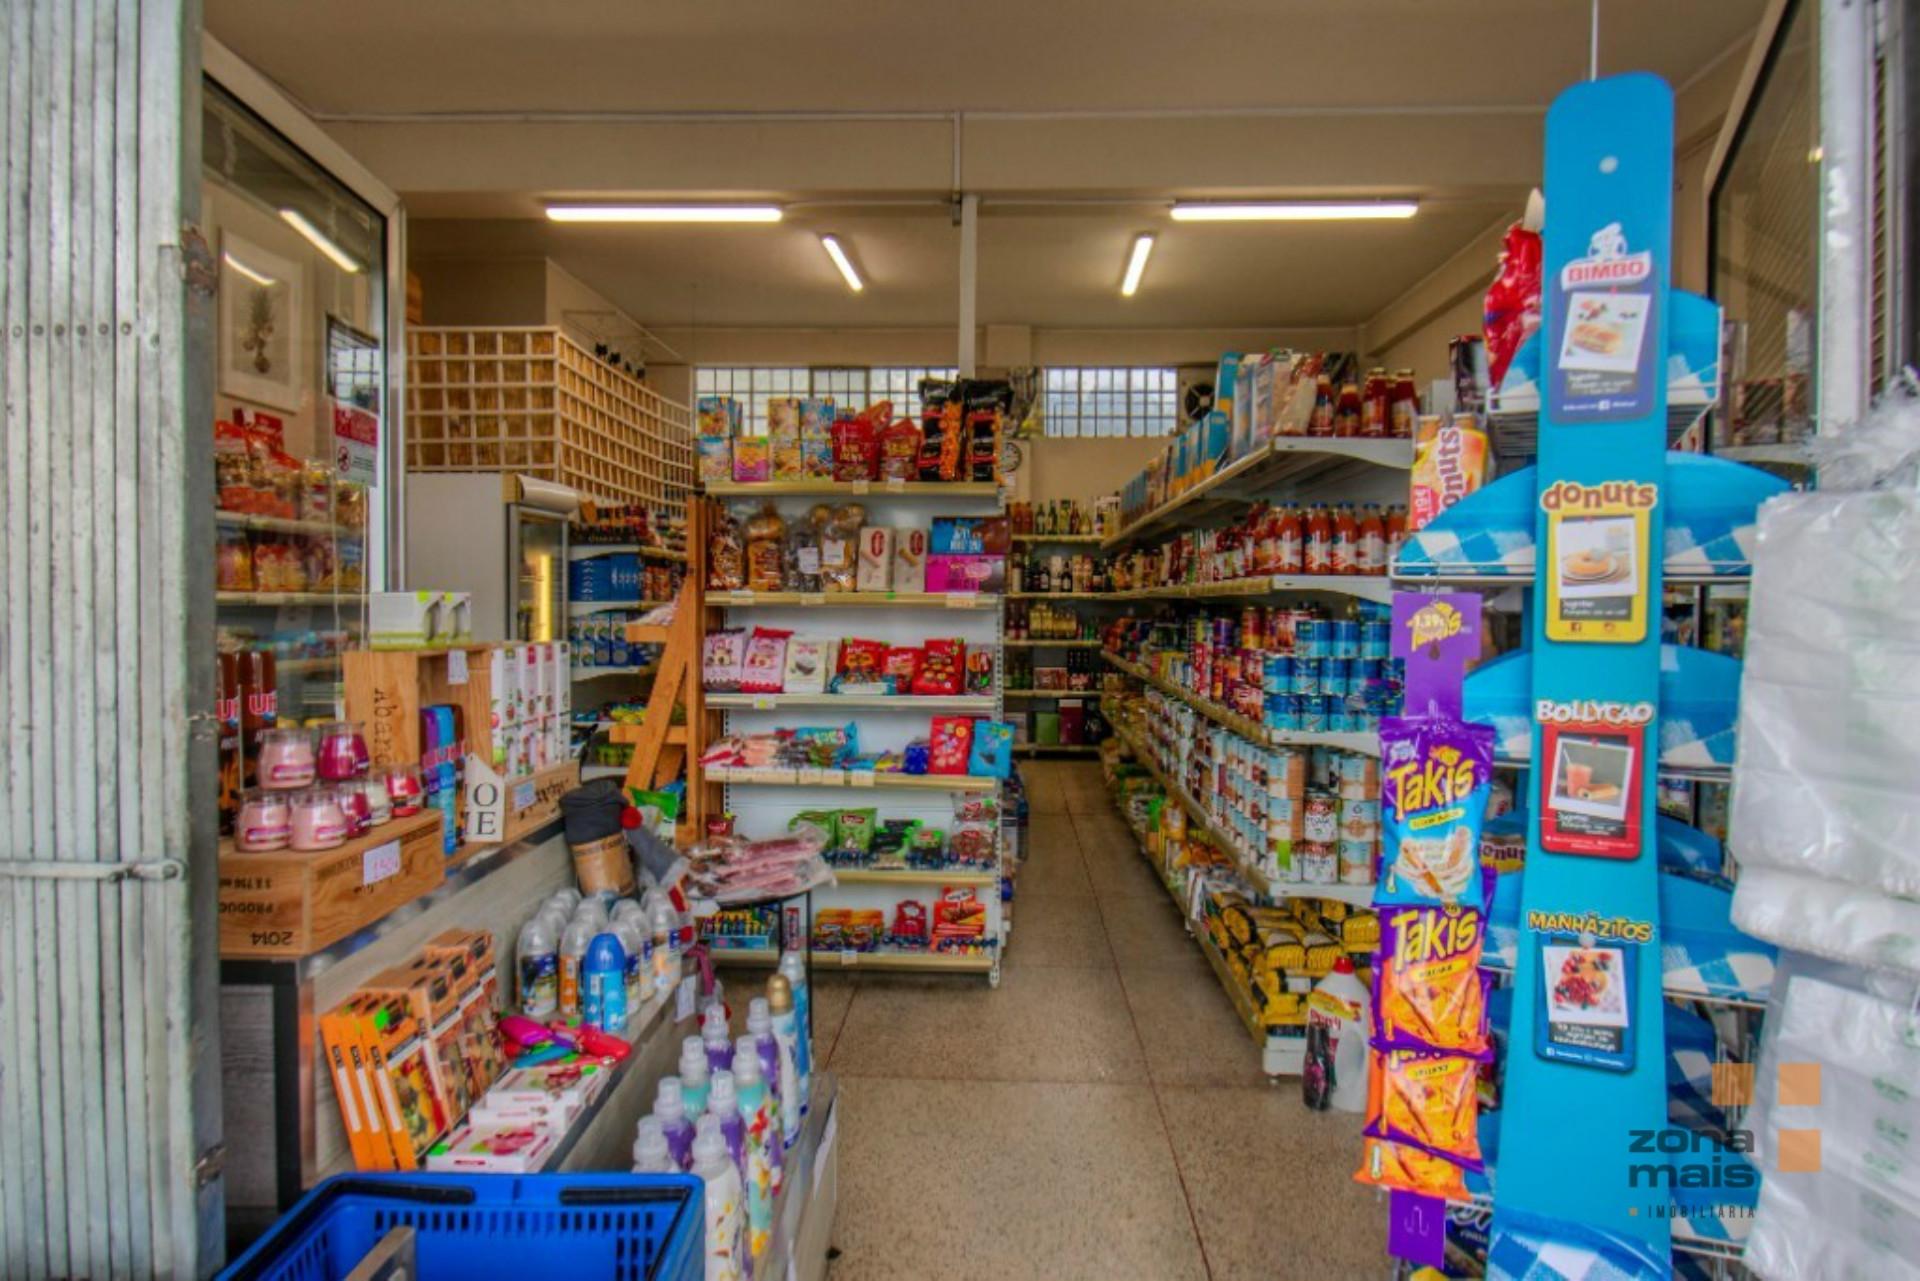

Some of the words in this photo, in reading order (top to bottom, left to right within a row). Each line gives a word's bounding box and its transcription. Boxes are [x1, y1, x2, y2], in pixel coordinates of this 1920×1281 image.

[1567, 257, 1646, 284] BIMBO
[1438, 427, 1463, 507] onuts
[1542, 481, 1658, 511] donuts
[1536, 699, 1654, 725] BOLLYCAO
[1388, 757, 1475, 822] Takis
[249, 931, 293, 946] 2014
[1390, 909, 1479, 972] Takis
